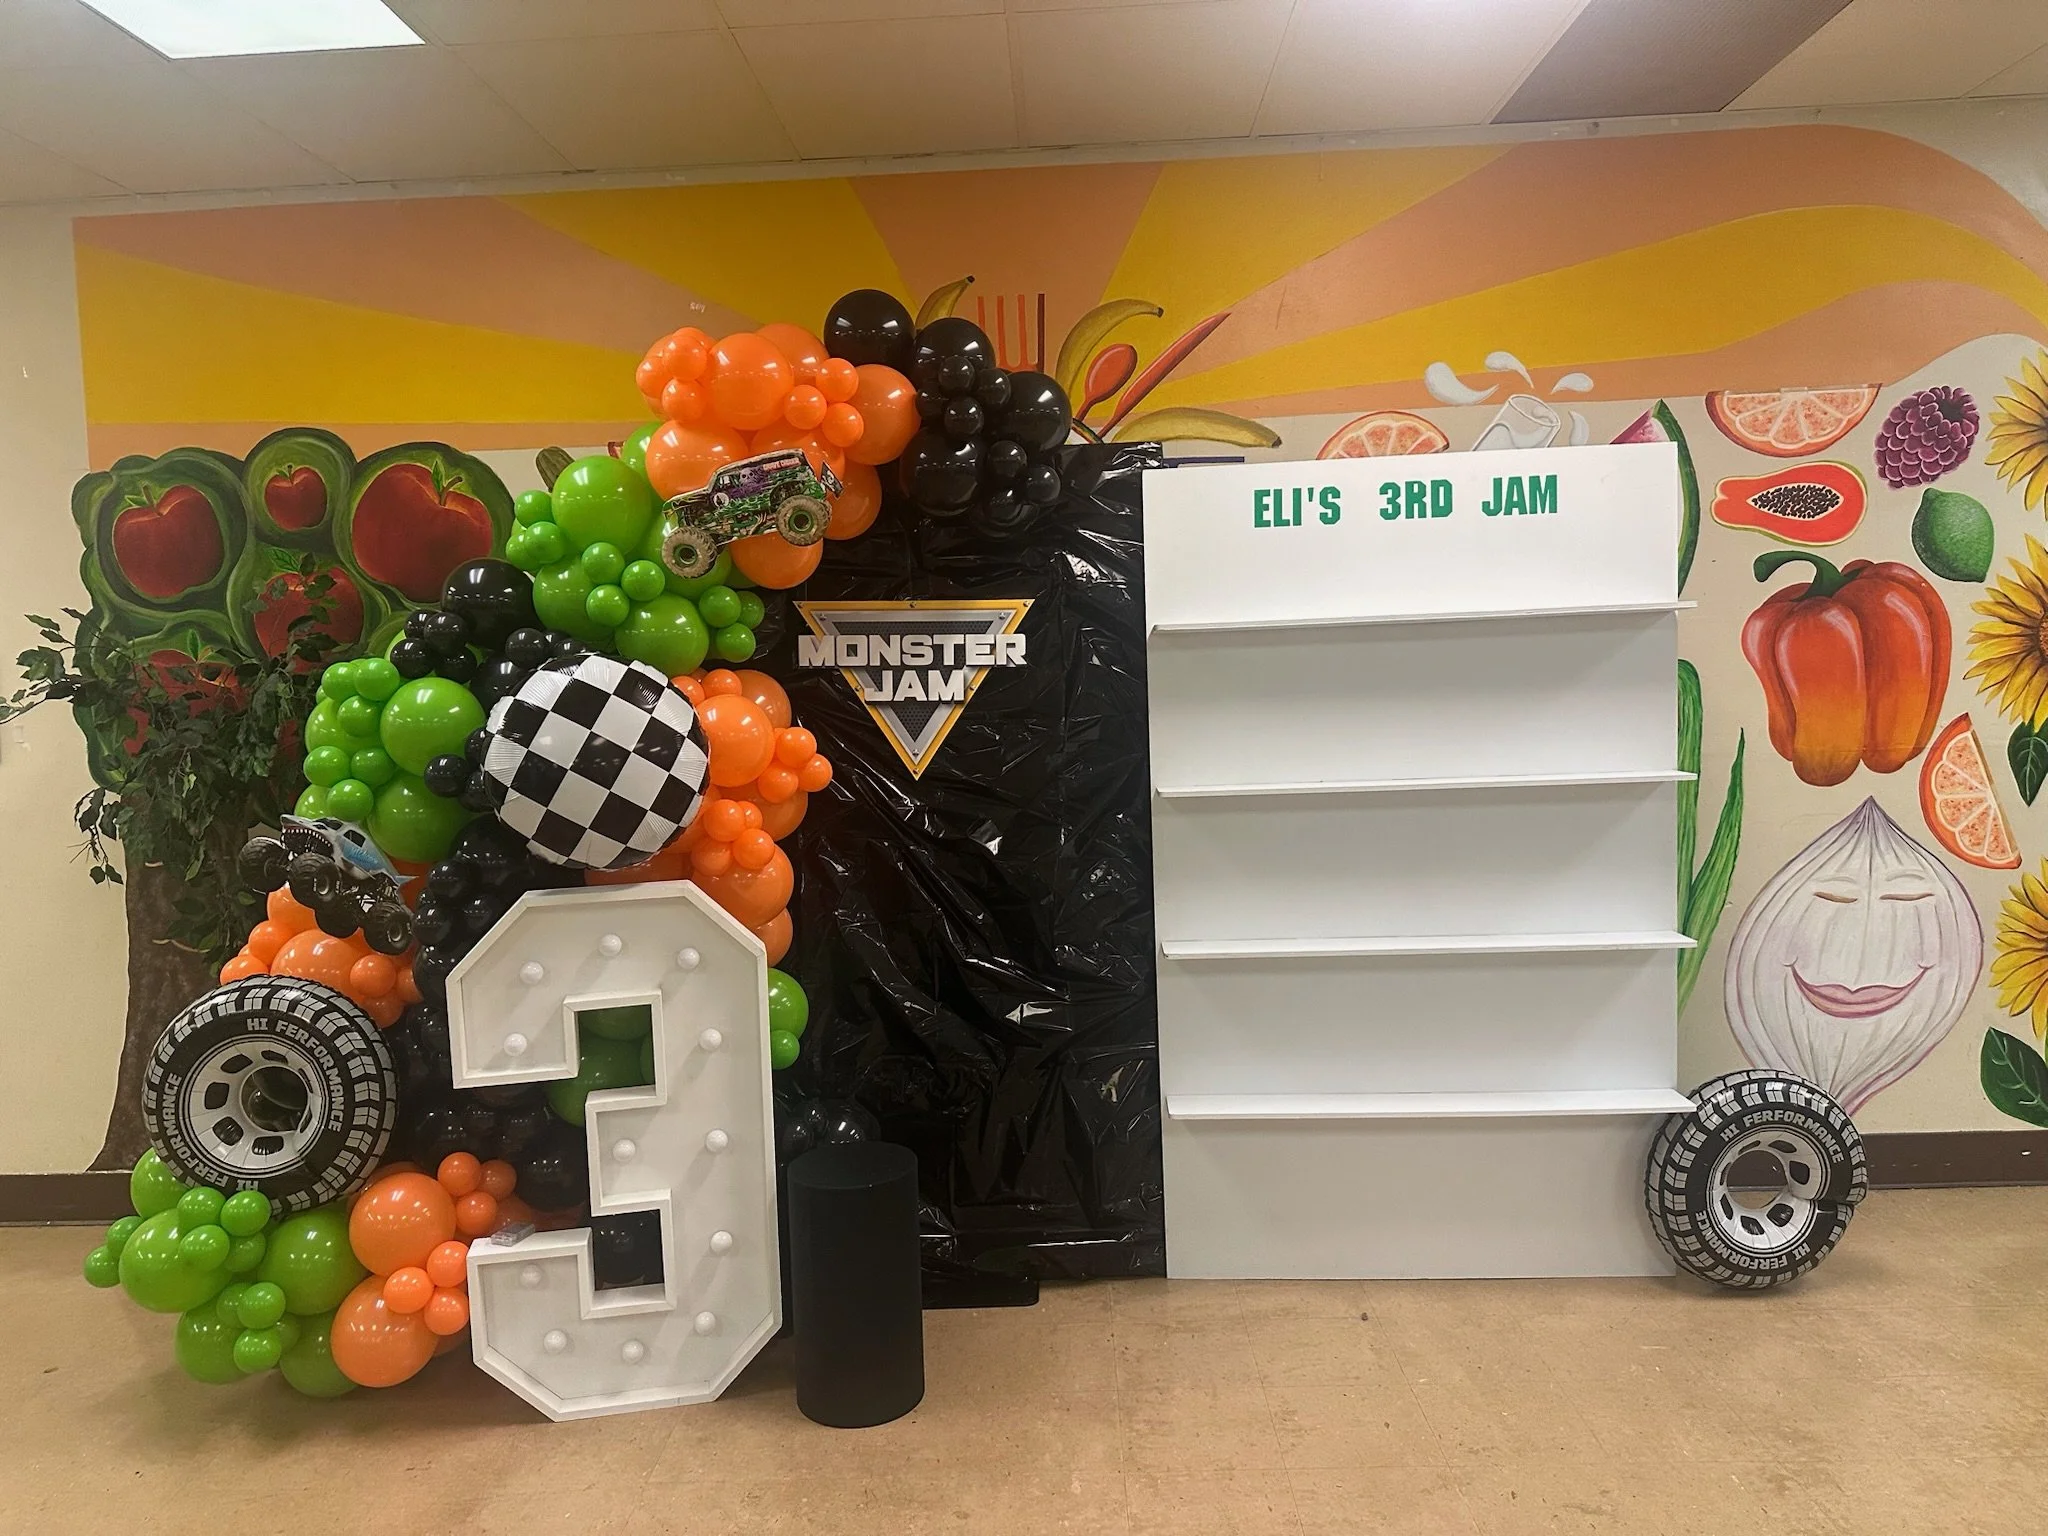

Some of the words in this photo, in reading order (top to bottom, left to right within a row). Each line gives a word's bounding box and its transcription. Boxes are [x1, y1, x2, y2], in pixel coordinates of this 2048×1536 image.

[1254, 486, 1341, 528] ELI'S
[1379, 479, 1453, 521] 3RD
[1481, 474, 1558, 517] JAM
[798, 633, 1028, 668] MONSTER
[864, 669, 965, 702] JAM
[246, 1017, 268, 1031] HI
[1720, 1123, 1741, 1142] HI
[1791, 1242, 1811, 1261] HI
